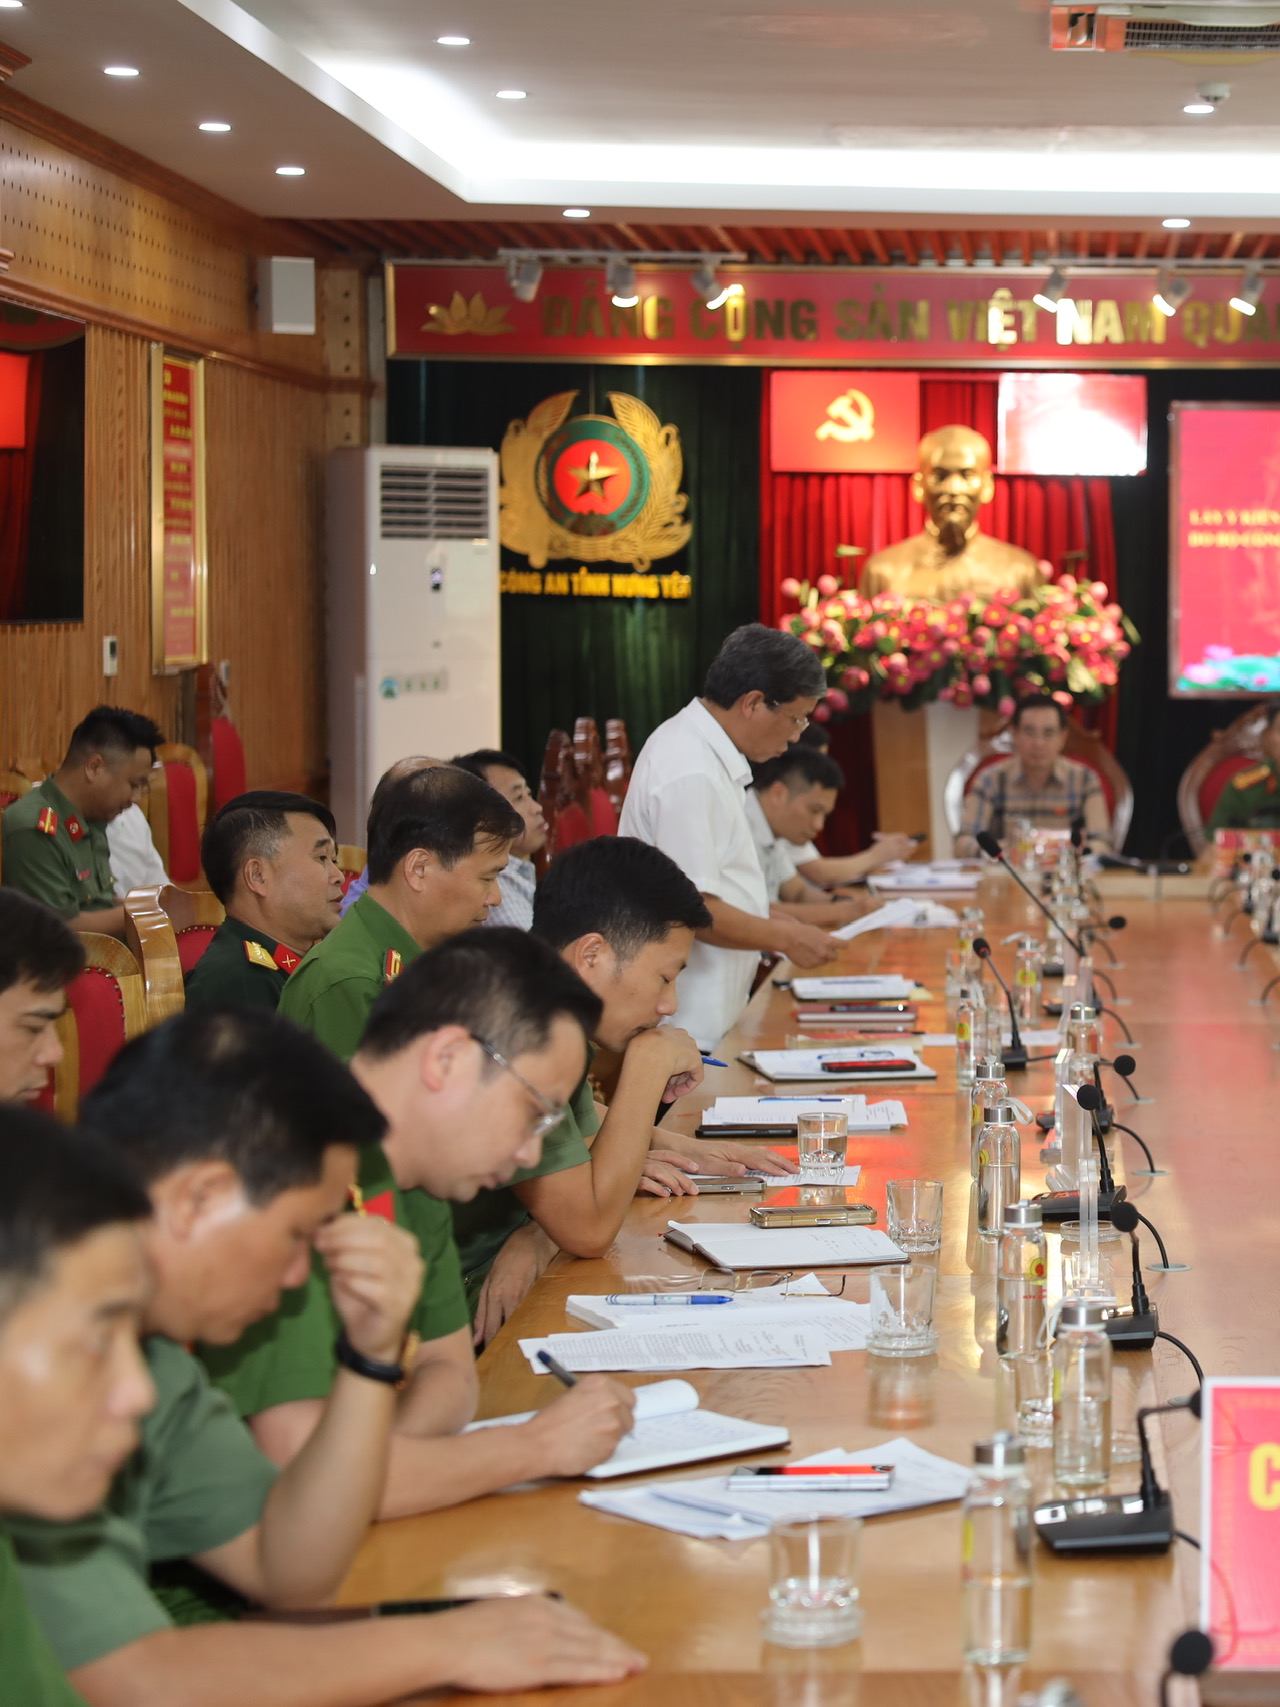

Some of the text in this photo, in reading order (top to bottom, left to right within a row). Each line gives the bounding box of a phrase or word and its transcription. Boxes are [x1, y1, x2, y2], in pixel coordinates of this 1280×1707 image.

[541, 279, 674, 340] ĐẢNG
[690, 284, 819, 350] CỘNG
[833, 282, 930, 341] SẢN
[947, 287, 1037, 351] VIỆT
[1056, 298, 1166, 345] NAM
